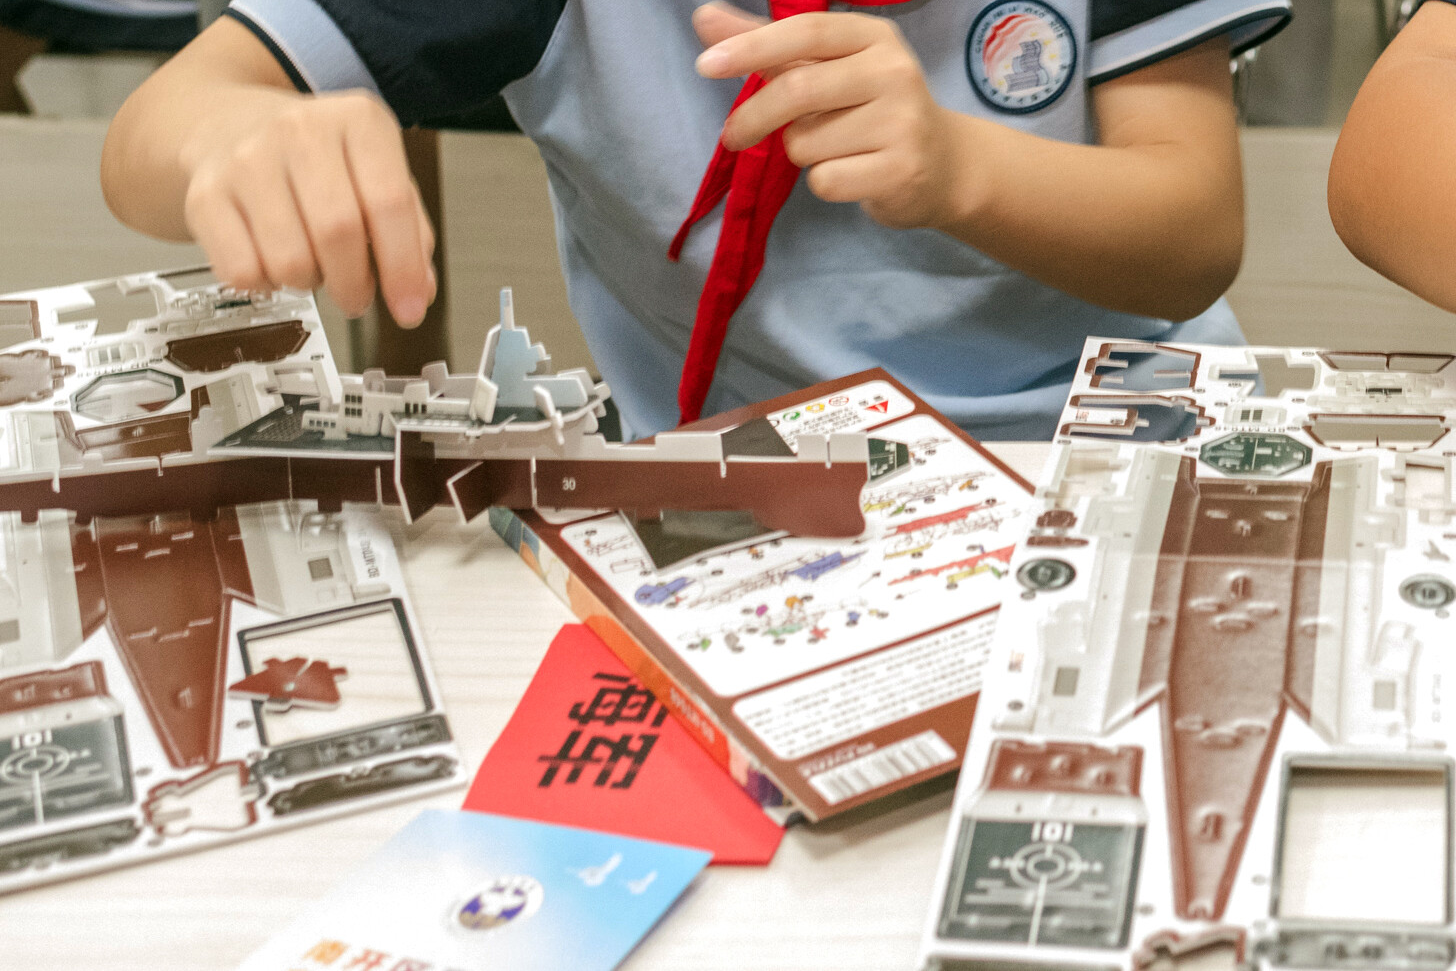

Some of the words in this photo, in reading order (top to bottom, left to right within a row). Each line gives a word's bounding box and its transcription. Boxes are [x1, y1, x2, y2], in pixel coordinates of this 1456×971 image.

[562, 477, 576, 490] 30
[12, 728, 53, 750] 101
[1031, 822, 1074, 843] 101
